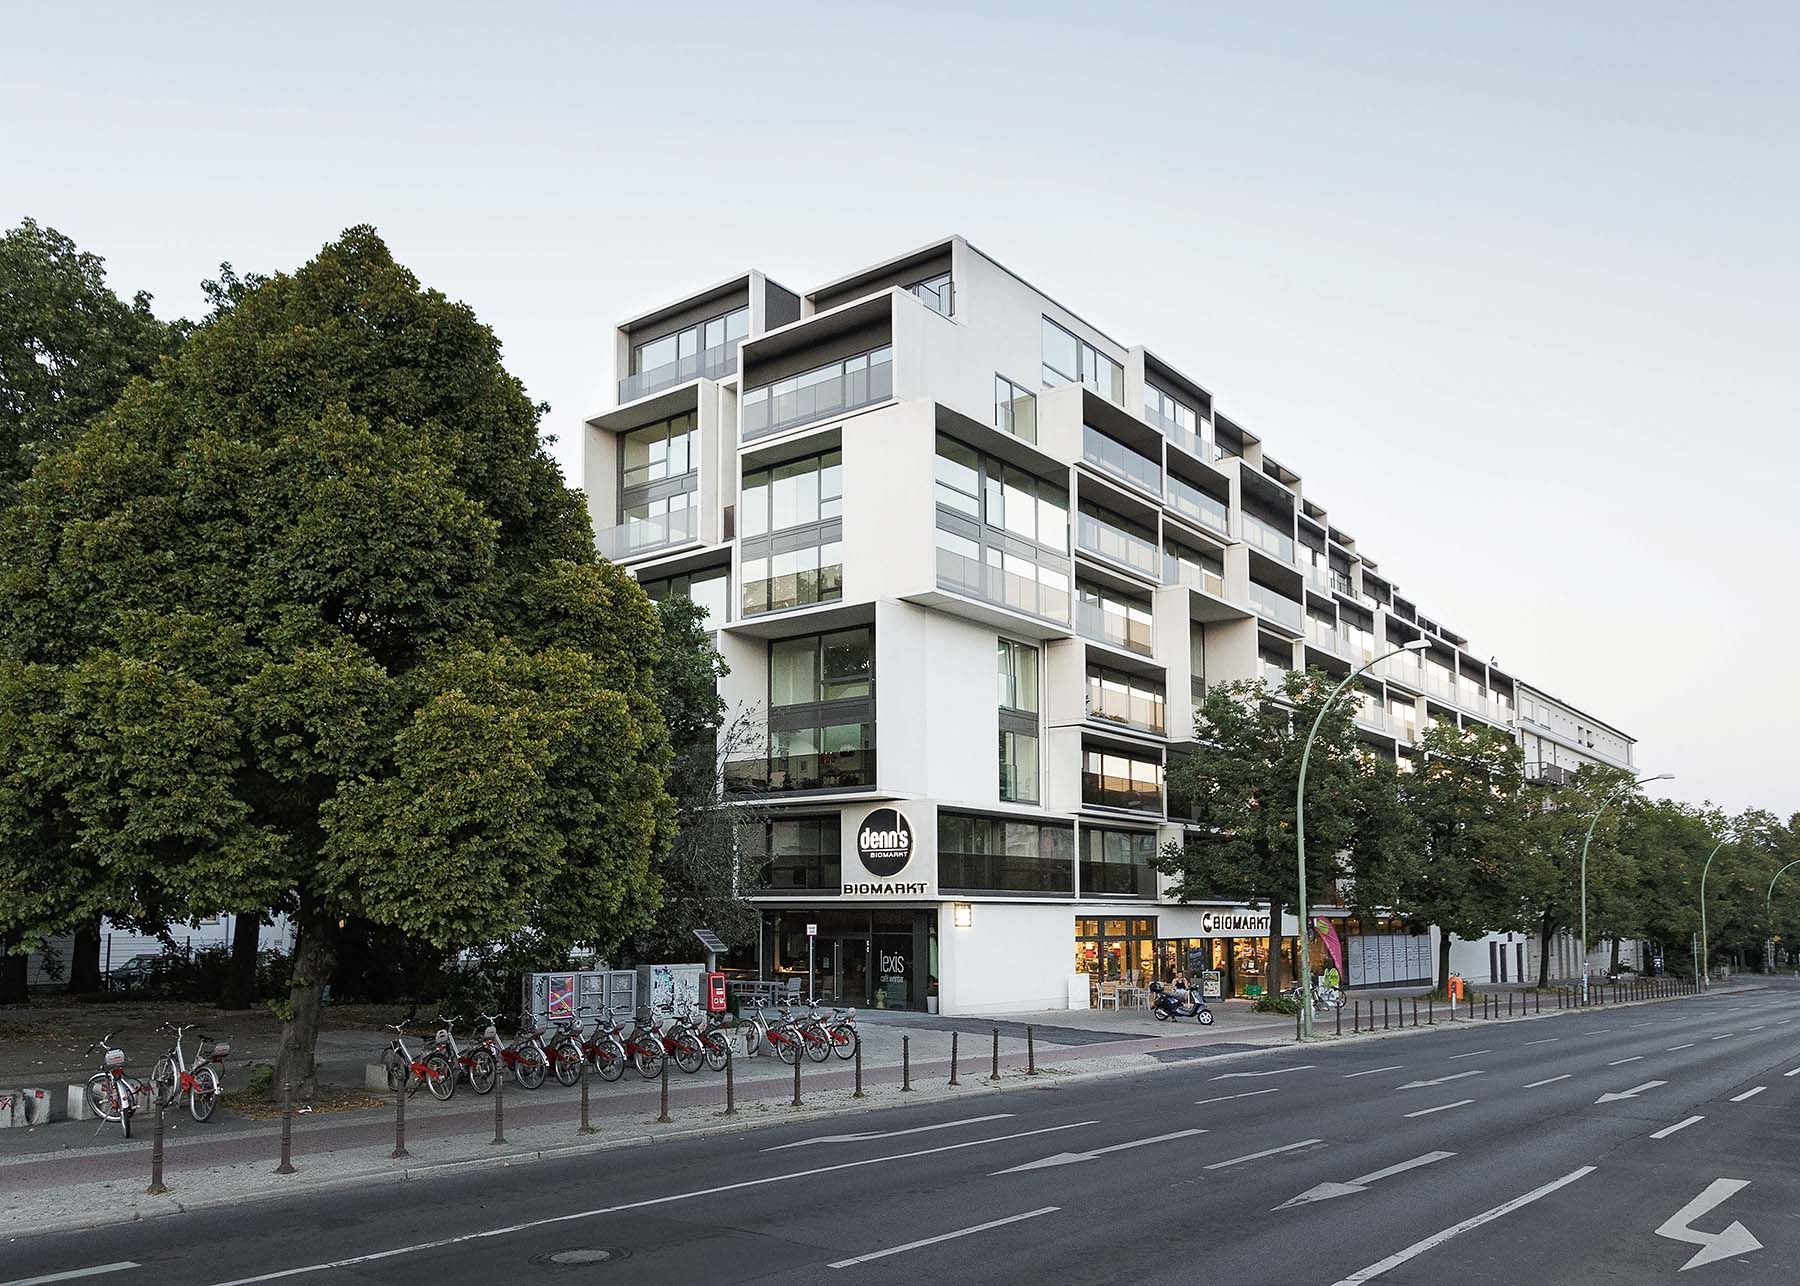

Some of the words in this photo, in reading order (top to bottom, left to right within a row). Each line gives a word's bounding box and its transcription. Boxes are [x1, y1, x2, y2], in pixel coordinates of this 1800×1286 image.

[843, 882, 928, 895] BIOMARKT
[1213, 916, 1270, 930] BIOMARKT
[880, 949, 905, 973] lexis
